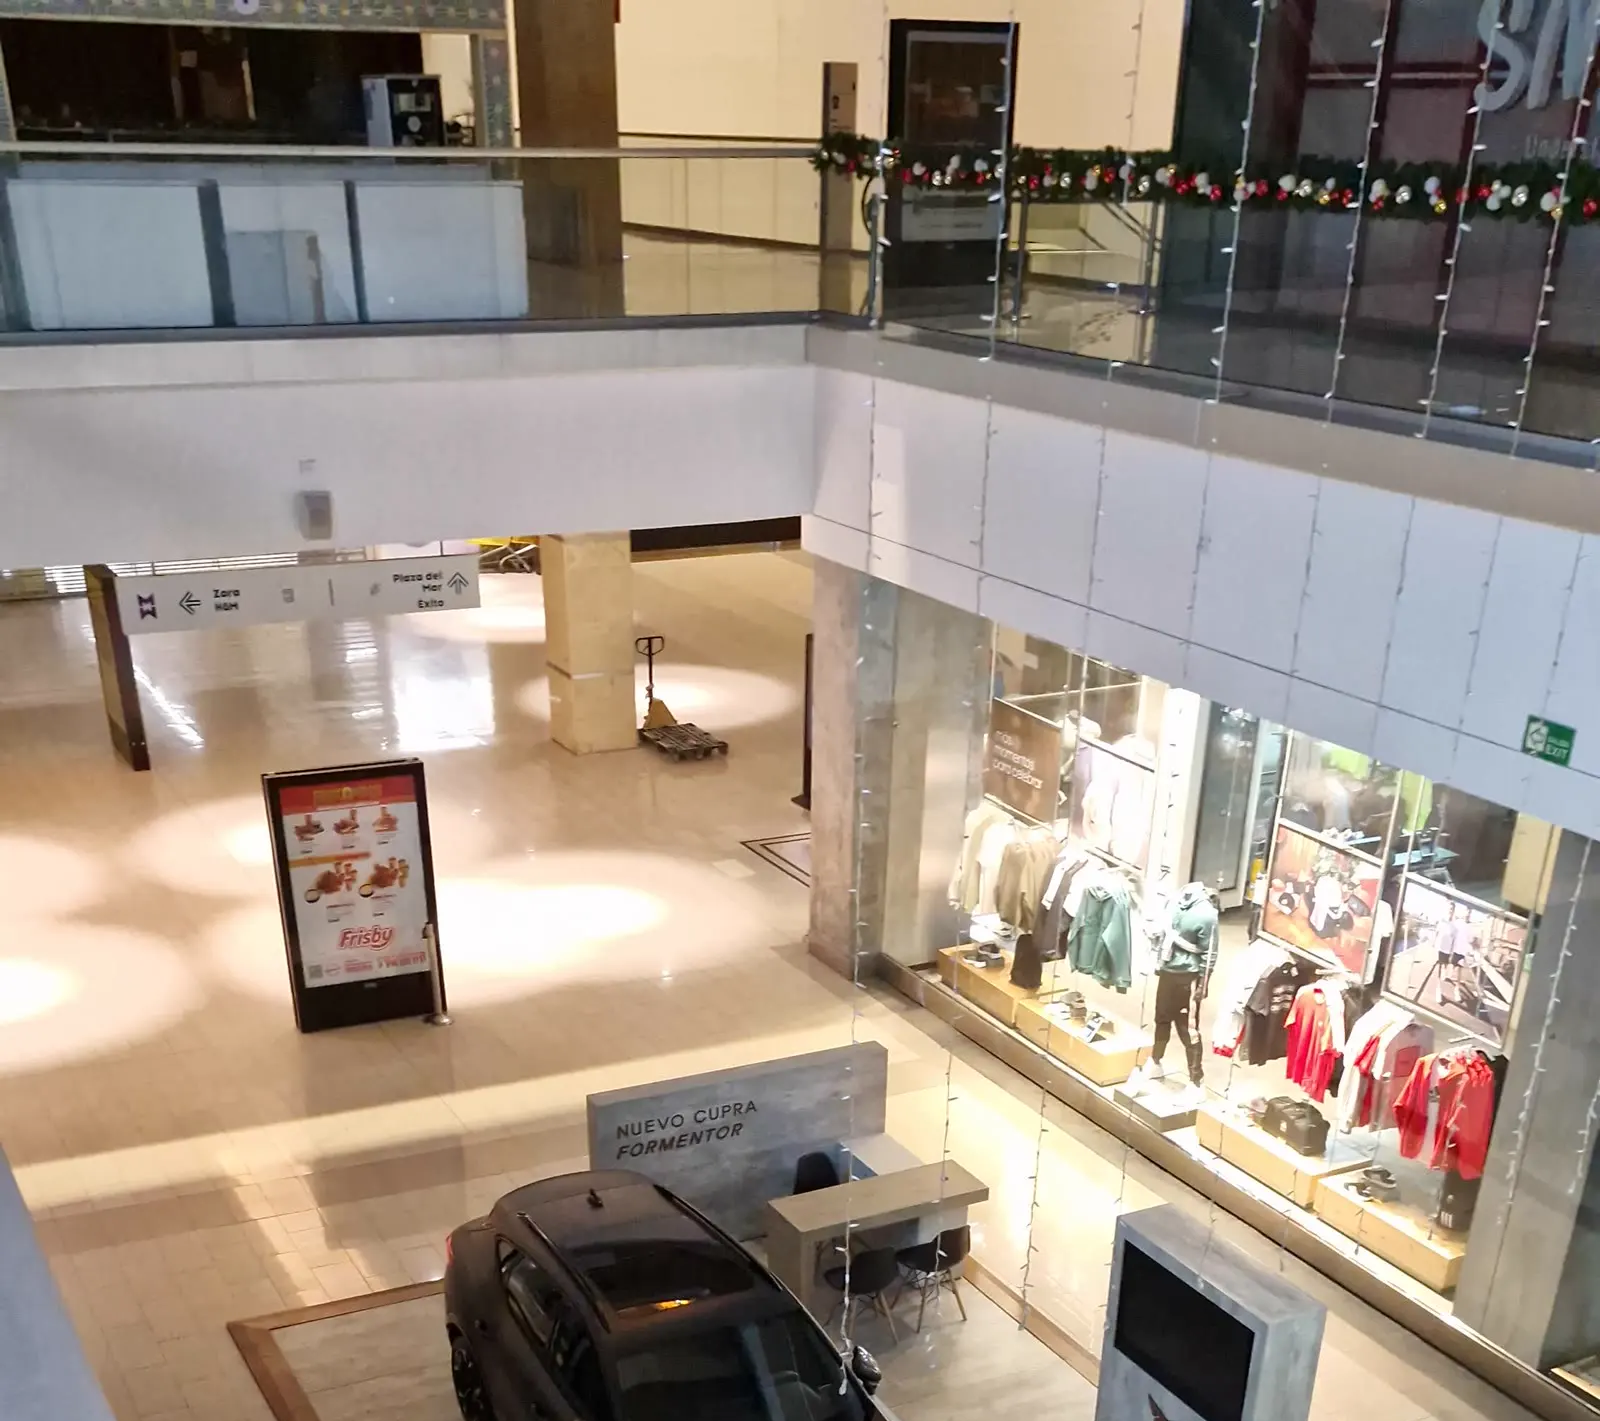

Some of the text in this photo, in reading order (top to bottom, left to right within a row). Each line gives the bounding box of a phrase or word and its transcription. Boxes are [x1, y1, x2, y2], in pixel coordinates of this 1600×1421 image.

[392, 571, 443, 583] Plaza del
[212, 588, 241, 600] Zara
[421, 583, 443, 593] Mar
[339, 924, 394, 951] Frisby
[616, 1100, 757, 1140] NUEVO CUPRA
[616, 1122, 744, 1161] FORMENTOR
